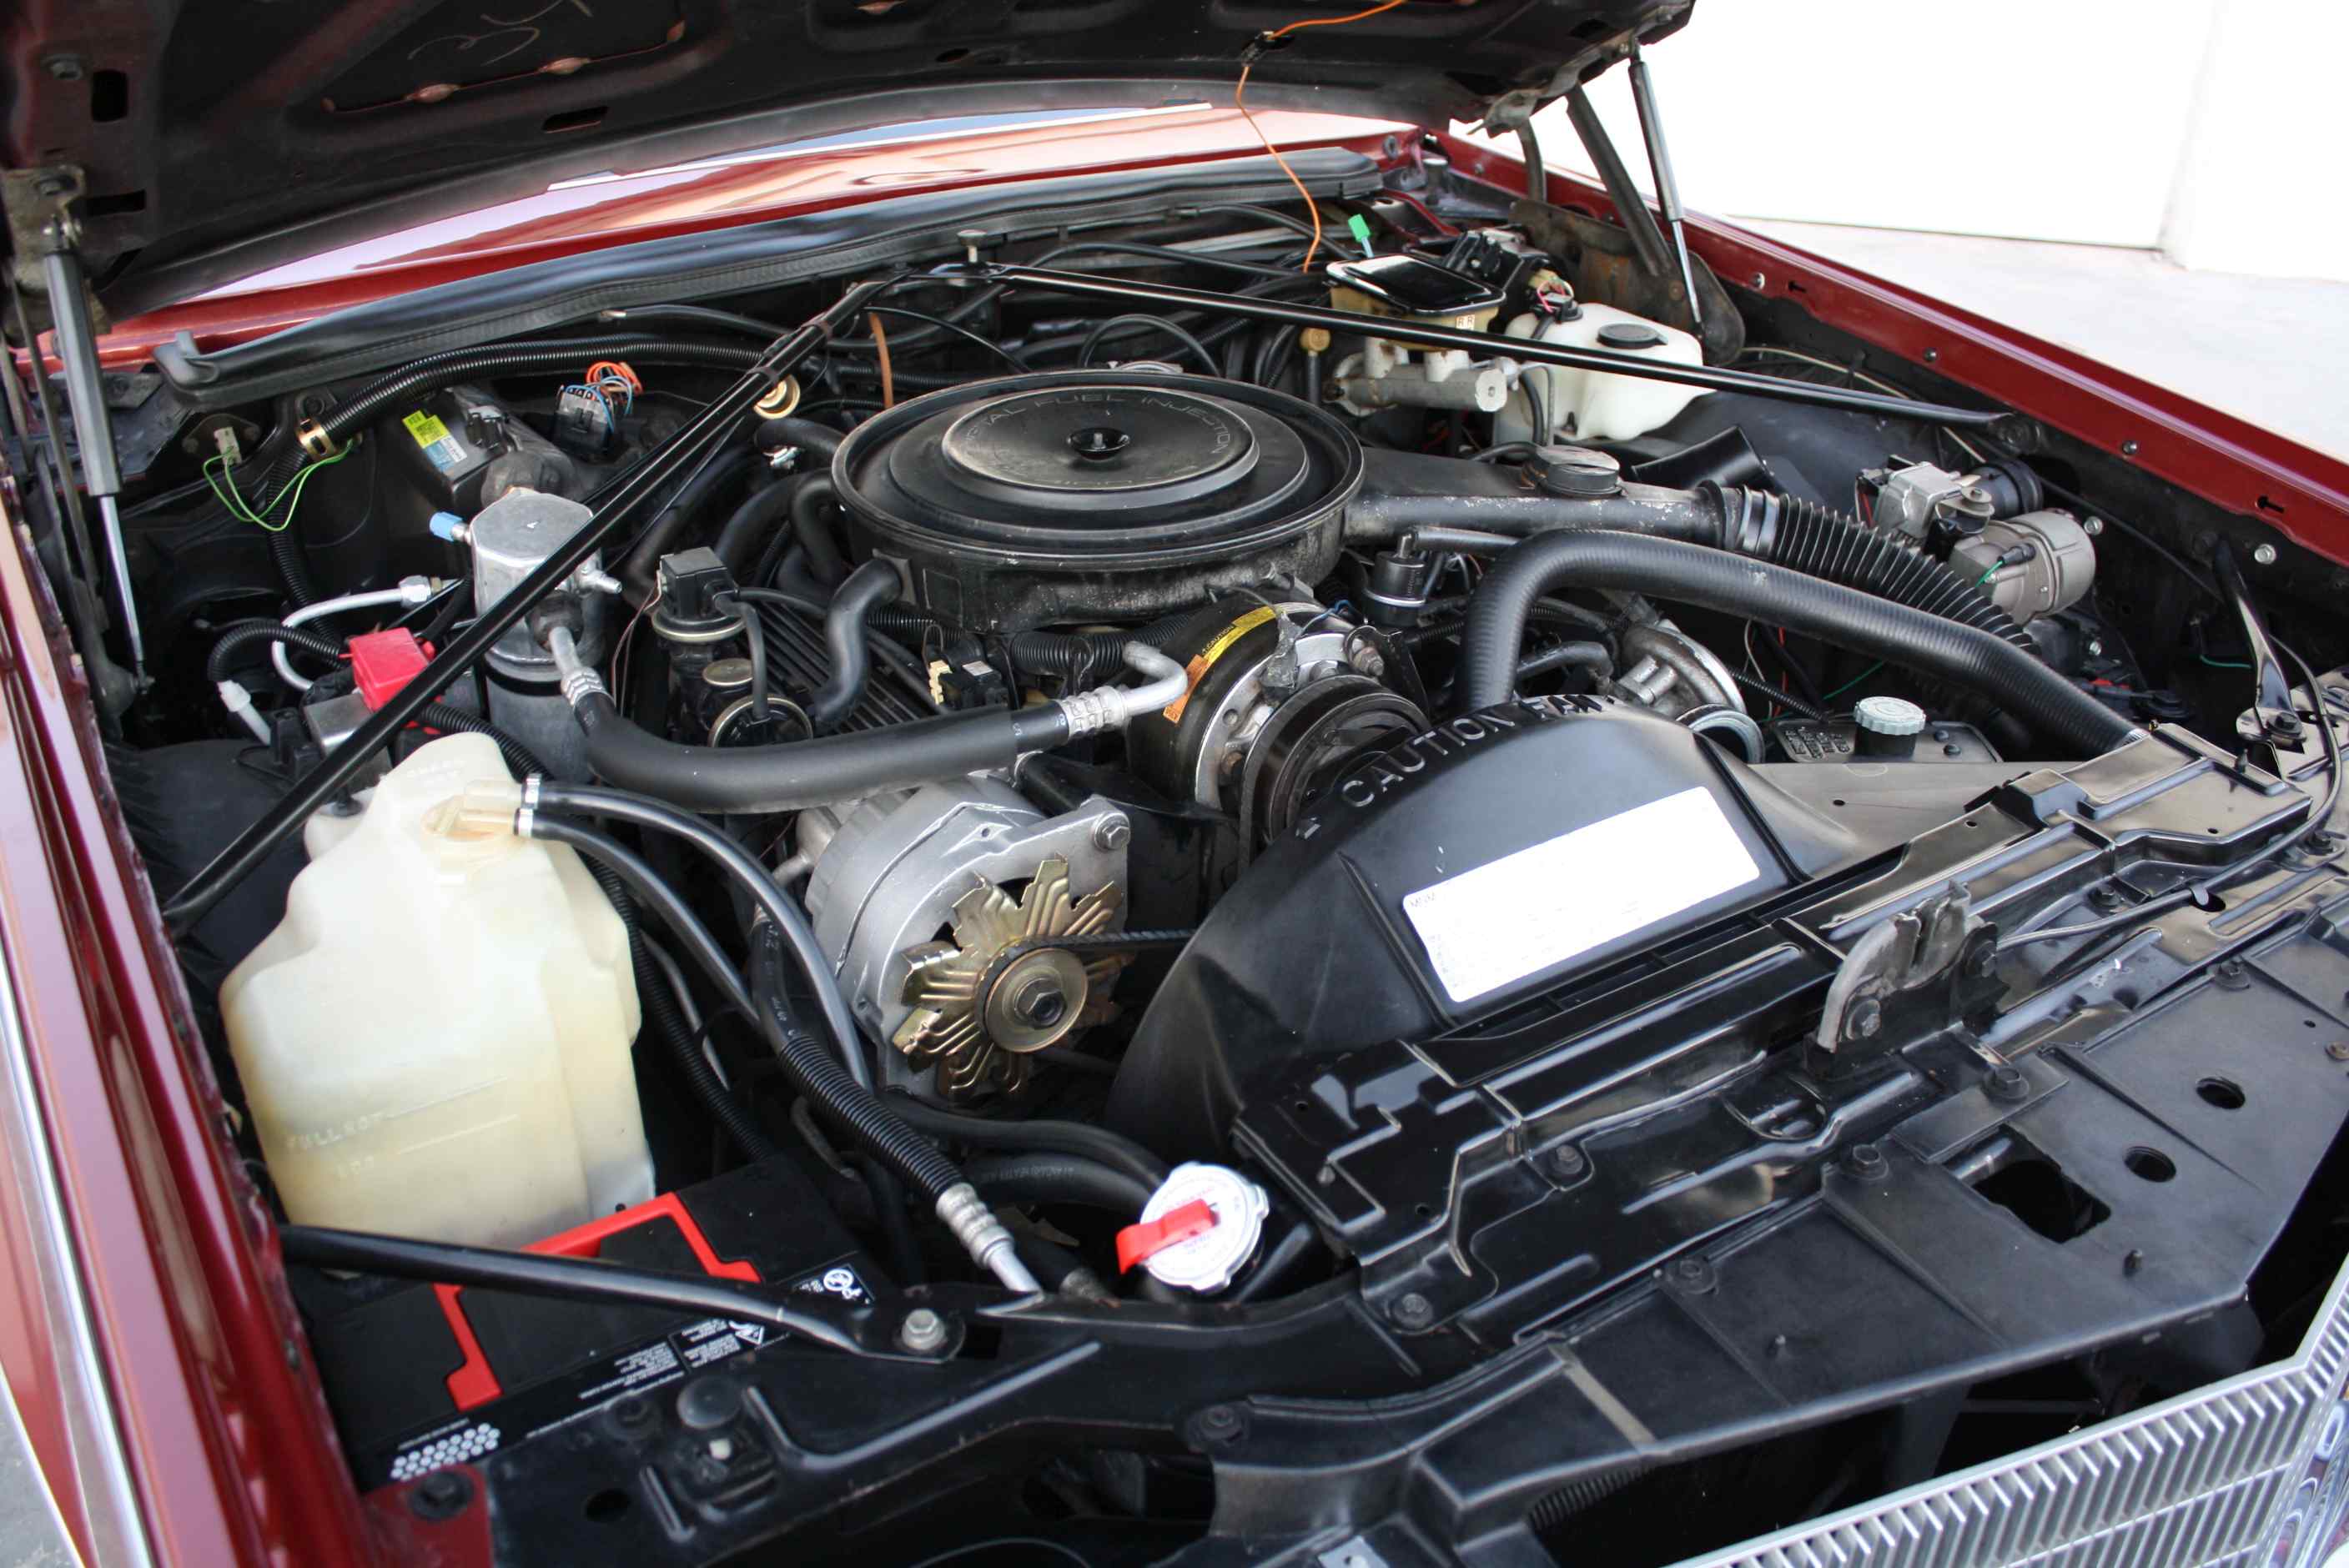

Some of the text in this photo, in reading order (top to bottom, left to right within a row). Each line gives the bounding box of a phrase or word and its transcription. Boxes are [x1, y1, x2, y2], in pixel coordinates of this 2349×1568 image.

[1034, 394, 1125, 407] FUEL
[1141, 396, 1232, 454] INJECTION
[1340, 693, 1603, 808] CAUTION FAN
